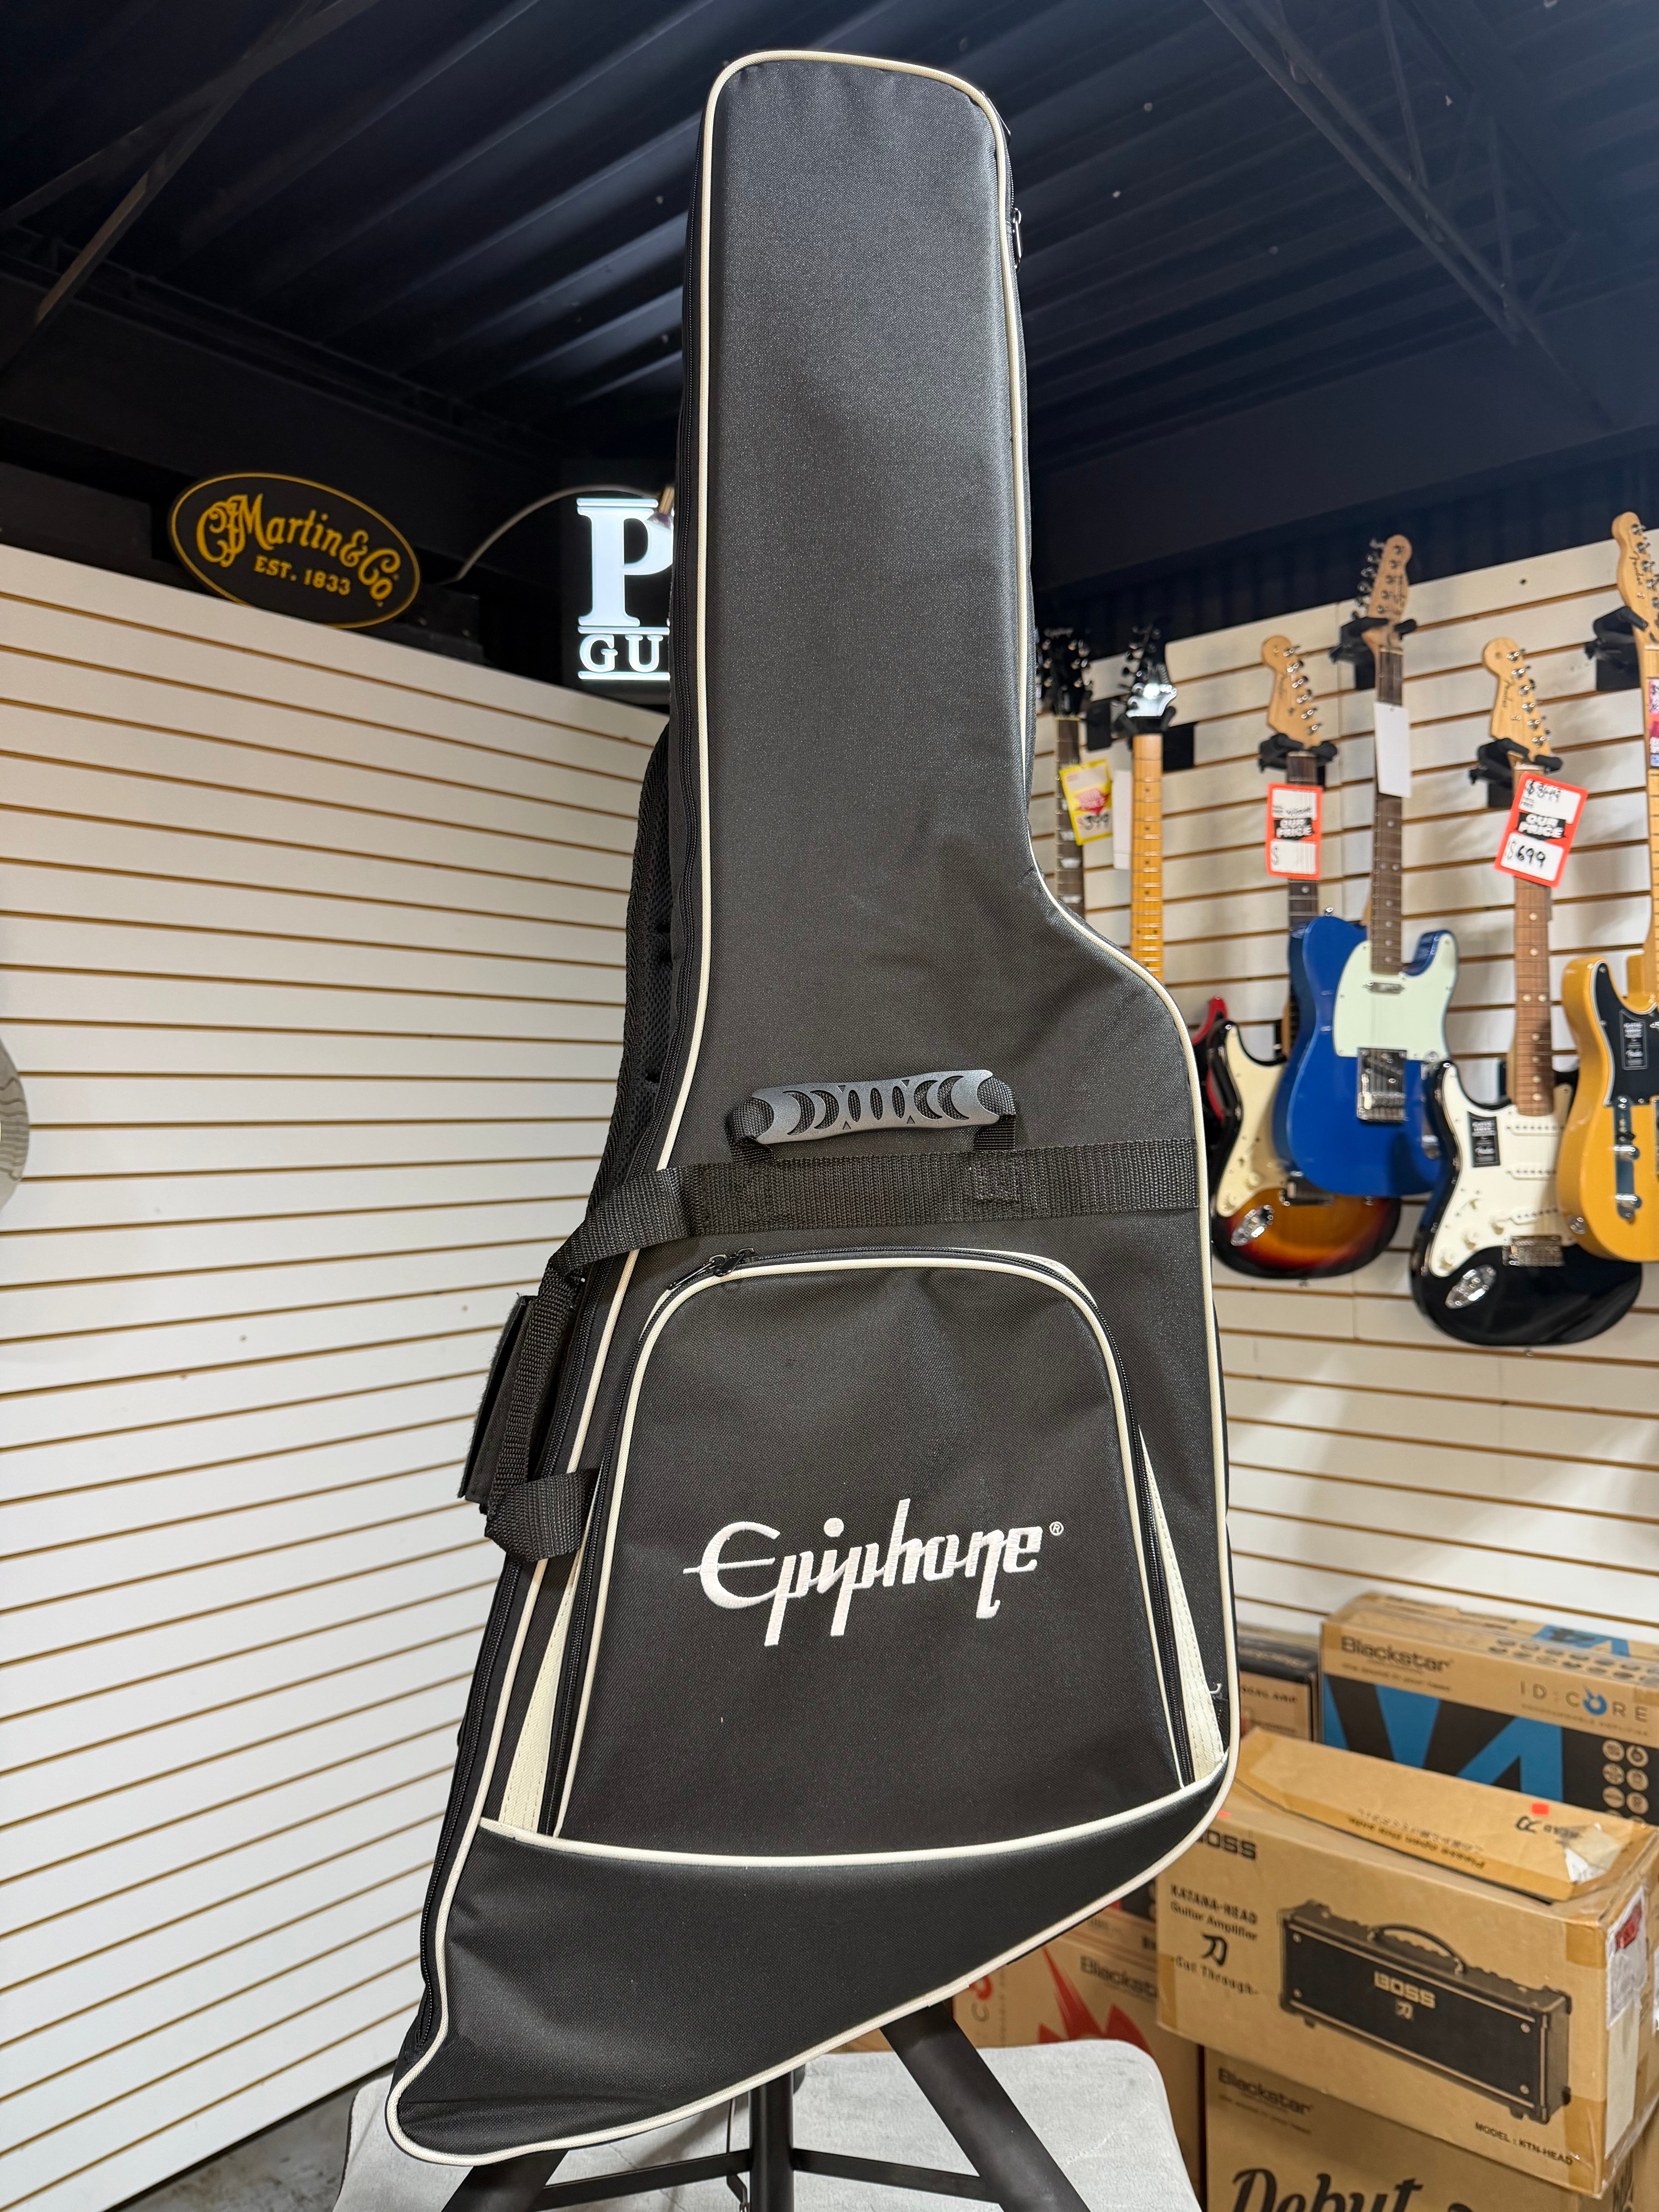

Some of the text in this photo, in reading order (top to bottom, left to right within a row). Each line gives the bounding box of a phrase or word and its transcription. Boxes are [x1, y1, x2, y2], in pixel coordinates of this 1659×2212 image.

[254, 555, 350, 596] EST. 1833
[1518, 821, 1564, 838] PRICE
[1526, 814, 1558, 828] OUR
[683, 1498, 1043, 1646] Epiphone
[1341, 1636, 1451, 1673] Blackstar
[1170, 1901, 1257, 1941] Guitar Amplifier
[1202, 1934, 1227, 1967] 刀
[1374, 1972, 1436, 2009] BOSS
[1218, 2068, 1311, 2115] Blackstar
[1475, 2122, 1510, 2143] MODEL
